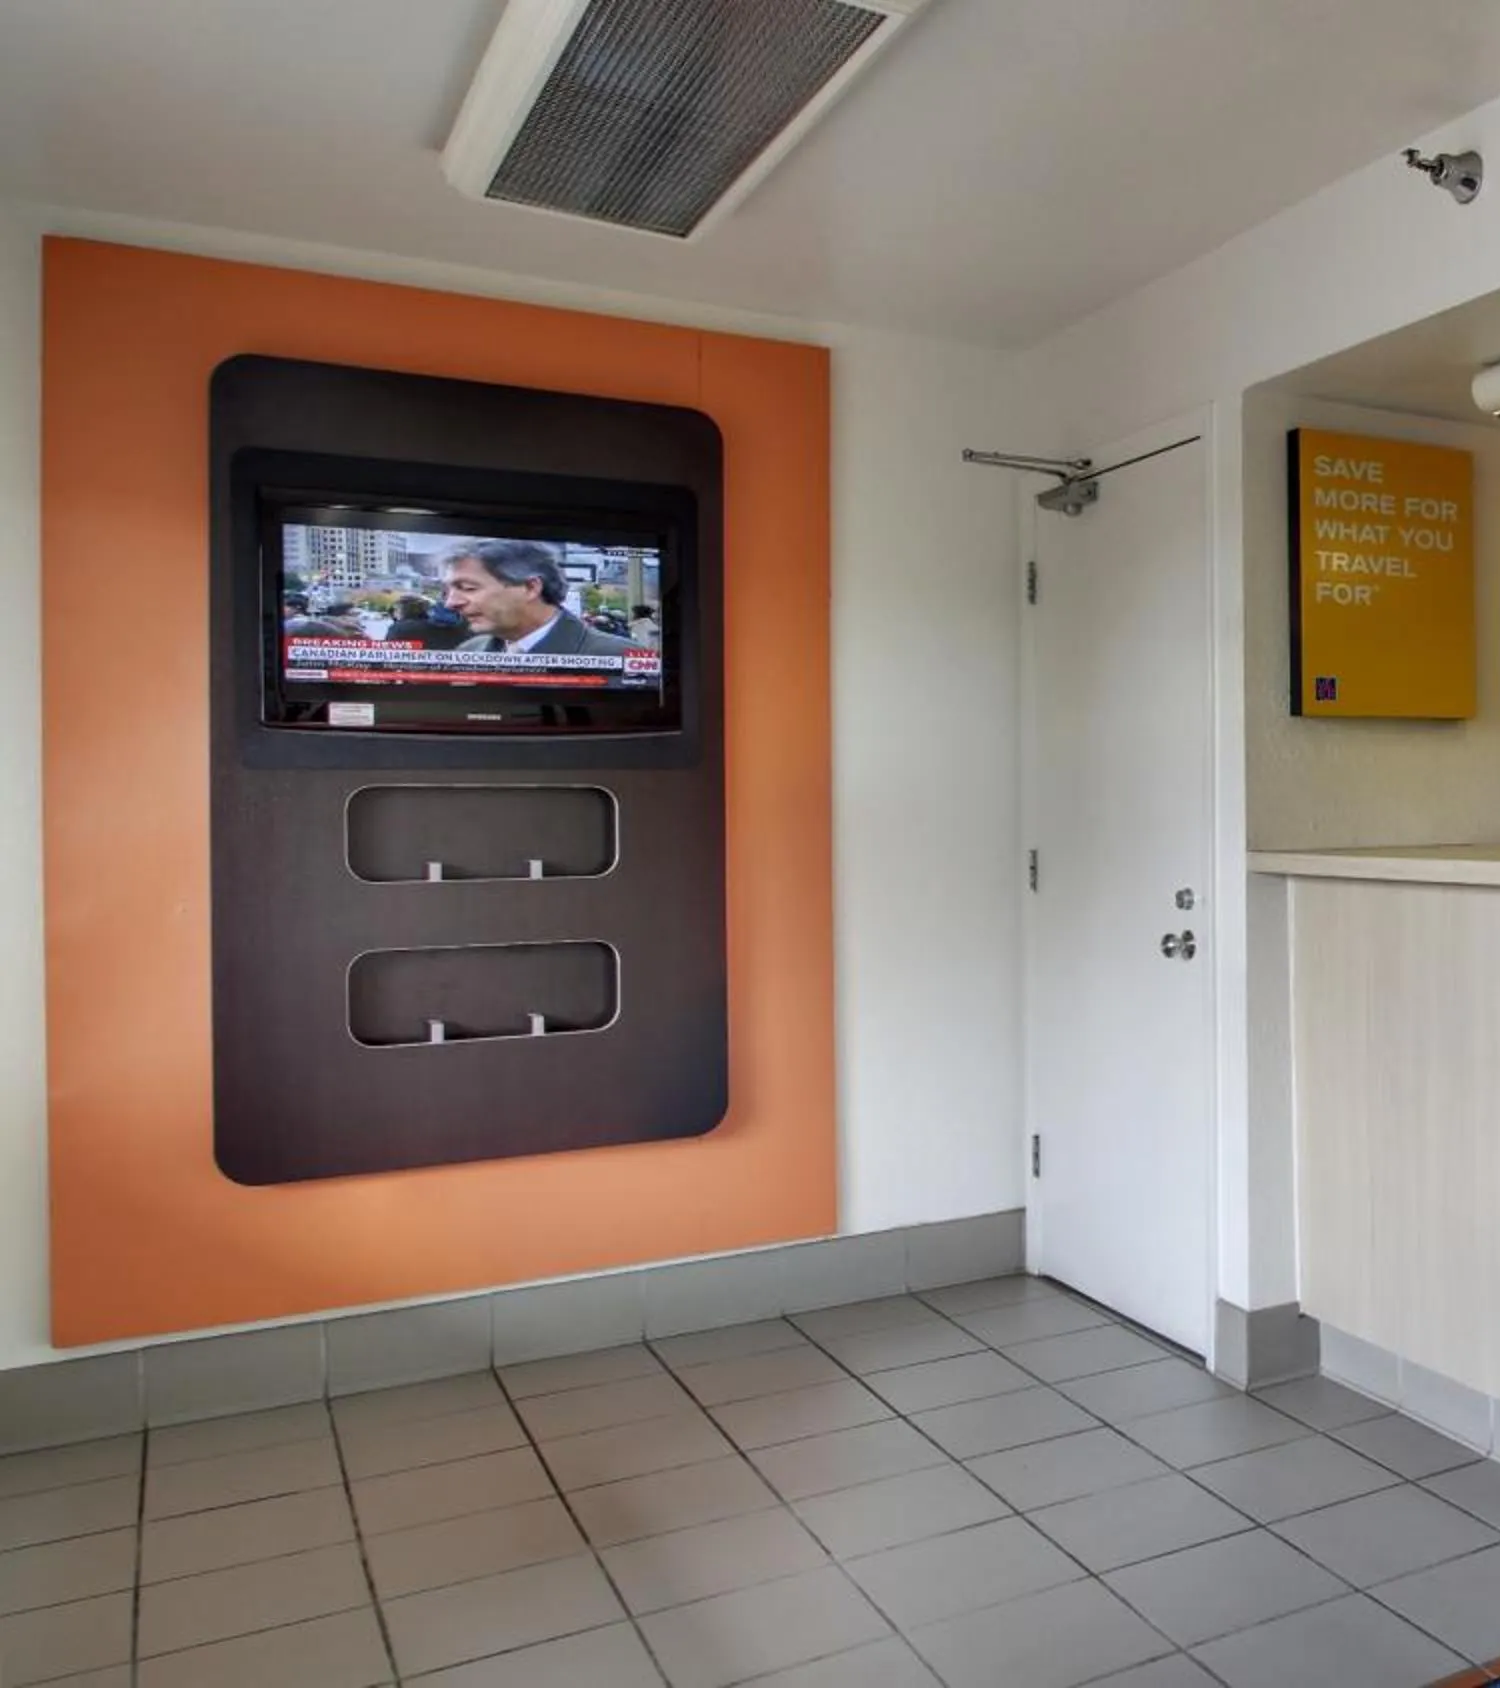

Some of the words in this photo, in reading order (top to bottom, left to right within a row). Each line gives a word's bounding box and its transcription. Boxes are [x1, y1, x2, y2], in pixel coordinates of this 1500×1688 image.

[1314, 455, 1384, 483] SAVE
[1314, 488, 1396, 516] MORE
[1405, 497, 1458, 522] FOR
[1315, 519, 1390, 544] WHAT
[1398, 526, 1454, 551] YOU
[1315, 550, 1418, 578] TRAVEL
[292, 637, 368, 648] BREAKING
[371, 640, 413, 650] NEWS
[292, 648, 357, 659] CANADIAN
[359, 650, 431, 661] PARLIAMENT
[434, 652, 453, 661] ON
[455, 653, 522, 663] LOCKDOWN
[524, 655, 558, 665] AFTER
[561, 657, 615, 667] SHOOTING
[628, 660, 659, 670] CNN
